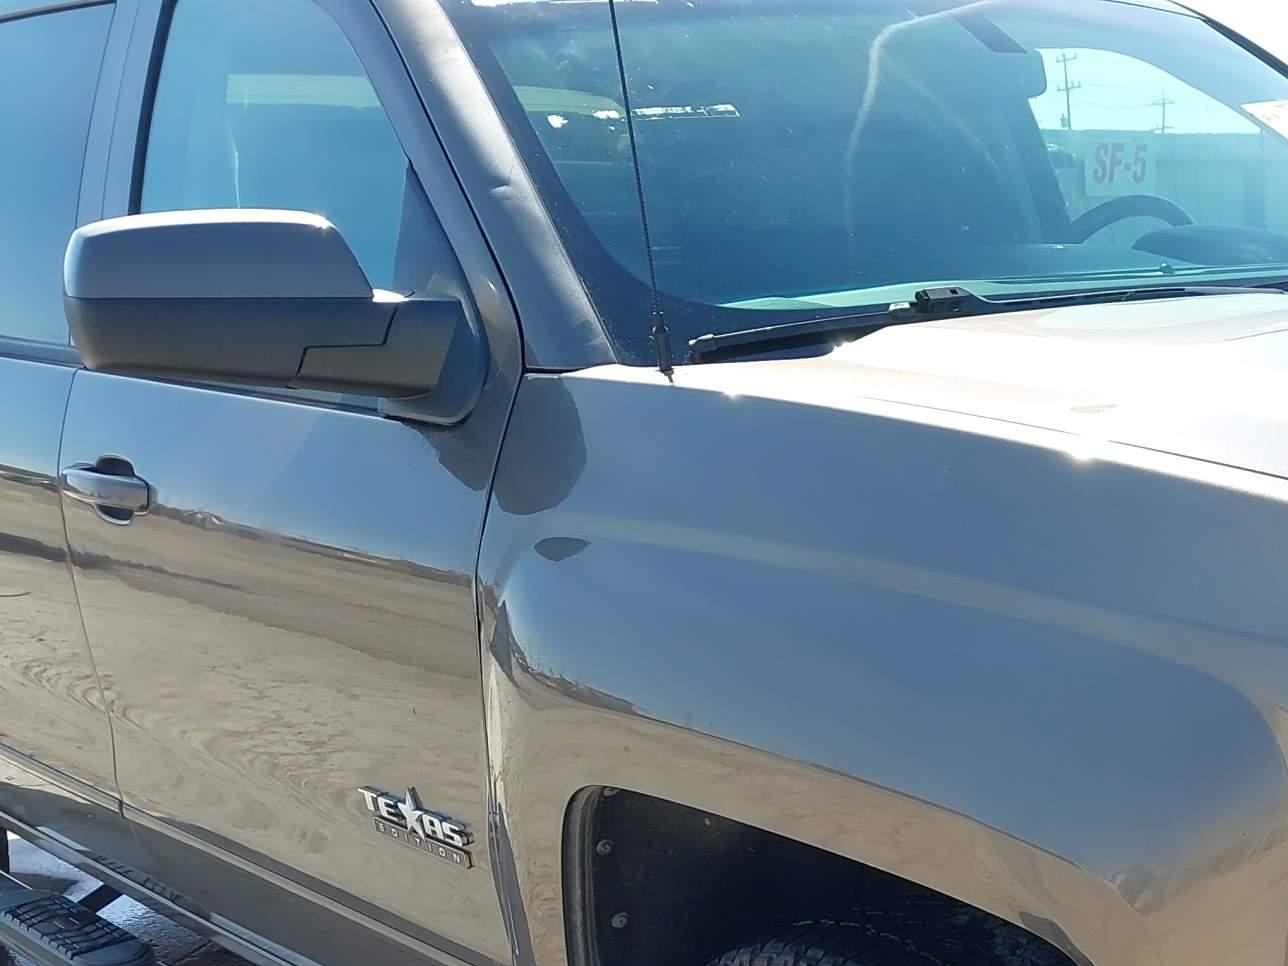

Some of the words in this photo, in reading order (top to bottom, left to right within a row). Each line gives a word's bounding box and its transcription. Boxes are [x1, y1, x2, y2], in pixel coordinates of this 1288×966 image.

[1092, 143, 1148, 184] SF-5
[357, 786, 467, 847] TEXAS
[378, 822, 461, 863] EDITION
